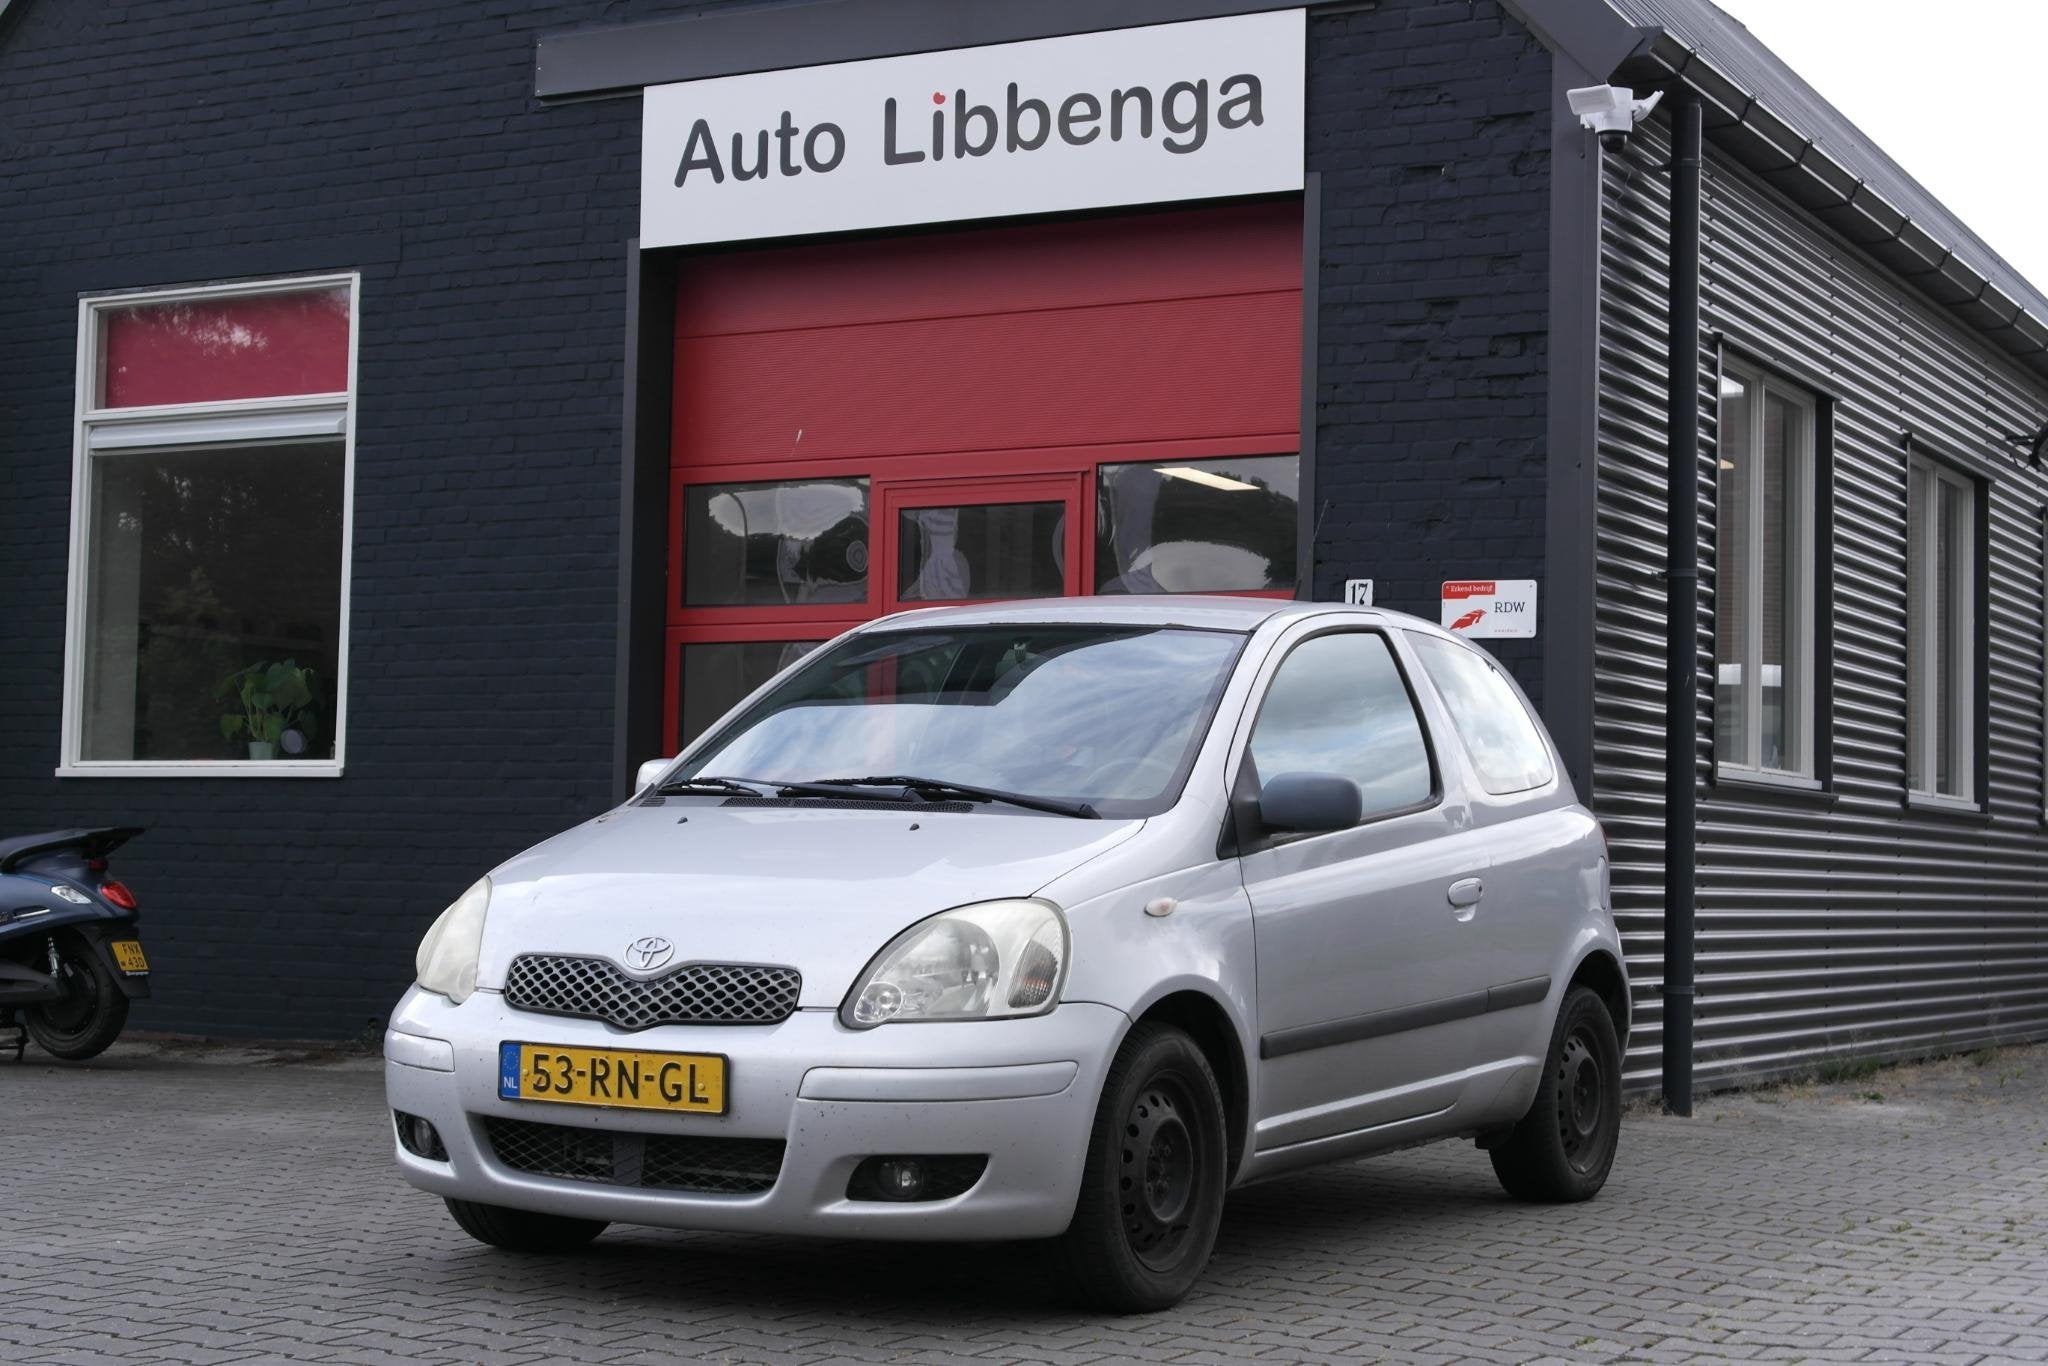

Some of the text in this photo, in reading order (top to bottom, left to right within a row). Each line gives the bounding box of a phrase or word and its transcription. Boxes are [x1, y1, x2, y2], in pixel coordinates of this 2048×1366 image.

[674, 72, 1265, 188] Auto Libbenga
[1351, 582, 1368, 605] 17
[1450, 584, 1493, 593] Erkend bedrijf
[1494, 601, 1525, 613] RDW
[503, 1076, 518, 1089] NL
[532, 1053, 709, 1104] 53-RN-GL
